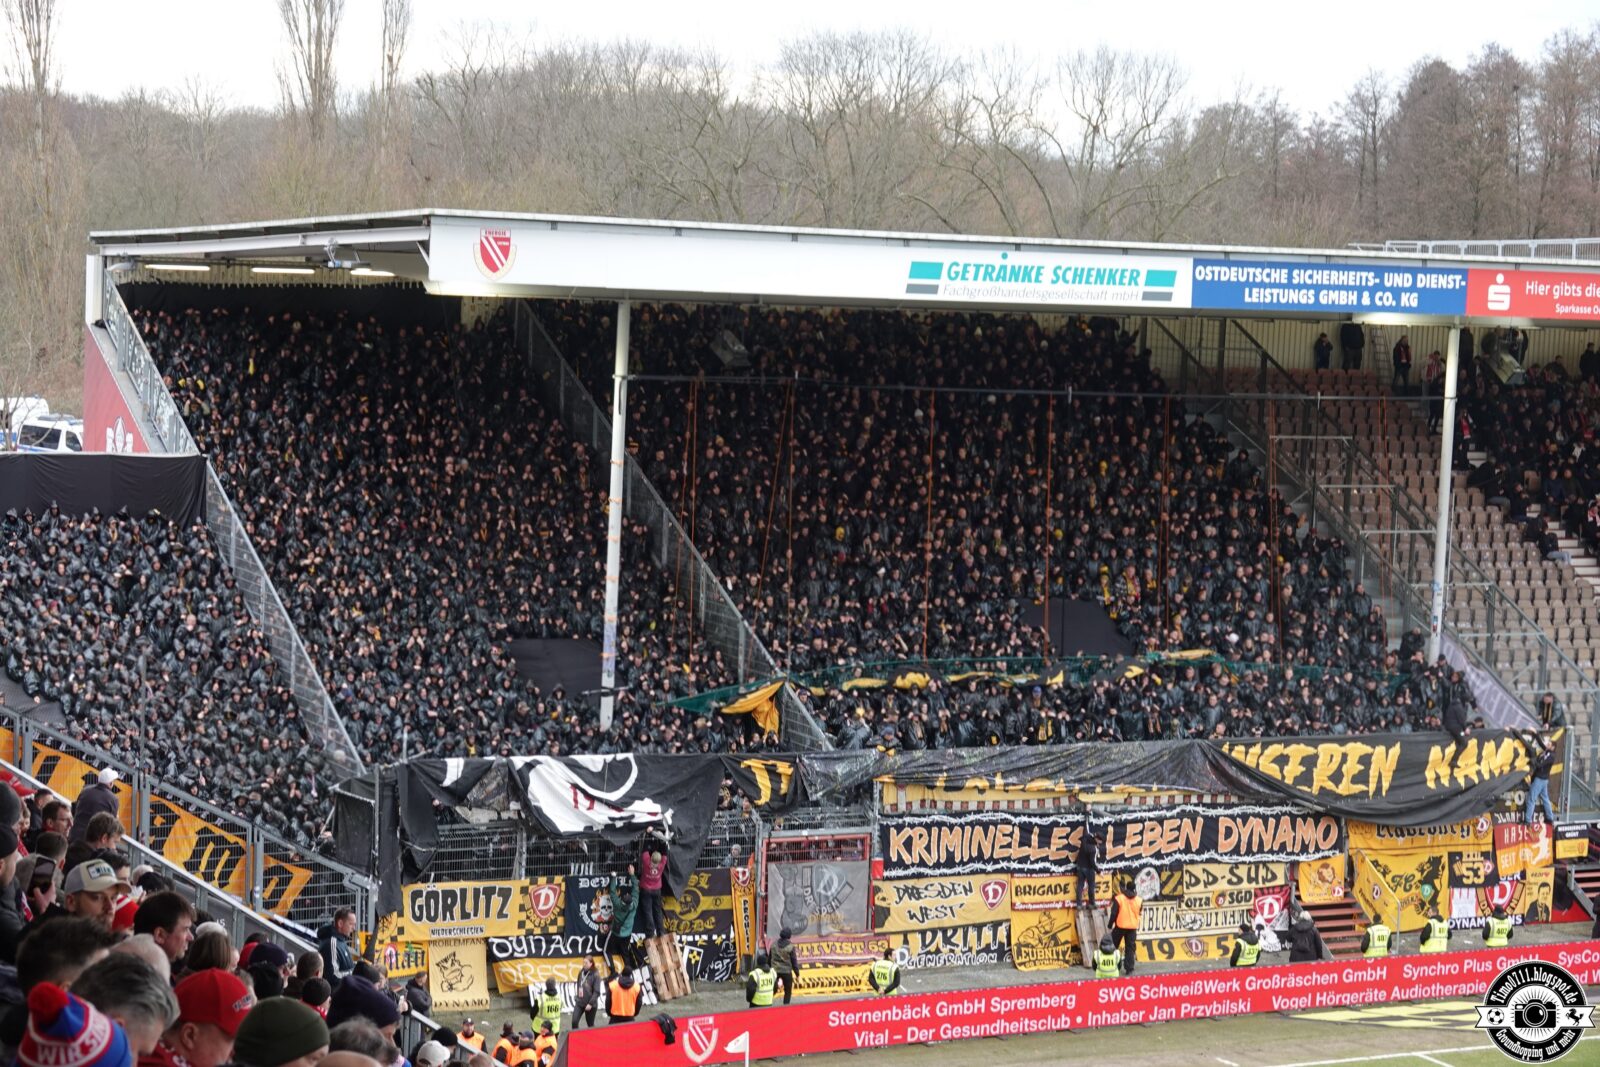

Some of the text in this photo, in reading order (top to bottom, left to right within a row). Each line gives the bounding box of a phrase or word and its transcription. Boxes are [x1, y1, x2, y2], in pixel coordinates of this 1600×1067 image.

[1050, 265, 1140, 286] SCHENKER
[1194, 265, 1466, 289] OSTDEUTSCHE SICHERHEITS- UND DIENST-
[943, 284, 1139, 301] Fachgroßhandelsgesellschaft mbH
[1244, 287, 1418, 308] LEISTUNGS GMBH & CO. KG
[1525, 281, 1550, 296] Hier
[1553, 282, 1582, 299] gibts
[1555, 303, 1591, 315] Sparkasse
[1105, 817, 1203, 860] LEBEN
[1217, 815, 1338, 855] DYNAMO
[1462, 863, 1485, 885] 53
[893, 880, 974, 905] DRESDEN
[1014, 883, 1071, 897] BRIGADE
[1228, 891, 1252, 904] SGD
[409, 884, 514, 923] GÖRLITZ
[907, 903, 965, 923] WEST
[526, 907, 561, 927] DRESDEN
[1013, 944, 1072, 964] LEUBNITZ
[1141, 939, 1175, 961] 19
[1402, 961, 1459, 981] Synchro
[1463, 957, 1492, 974] Plus
[1098, 965, 1387, 1004] SWG SchweißWerk Großräschen GmbH
[1272, 979, 1487, 1010] Vogel Hörgeräte Audiotherapie
[433, 999, 488, 1009] DYNAMO
[828, 993, 1076, 1028] Sternenbäck GmbH Spremberg
[1088, 998, 1251, 1026] Inhaber Jan Przybilski
[854, 1028, 889, 1047] Vital
[907, 1026, 936, 1043] Der
[939, 1014, 1071, 1040] Gesundheitsclub
[38, 1043, 80, 1065] WIR
